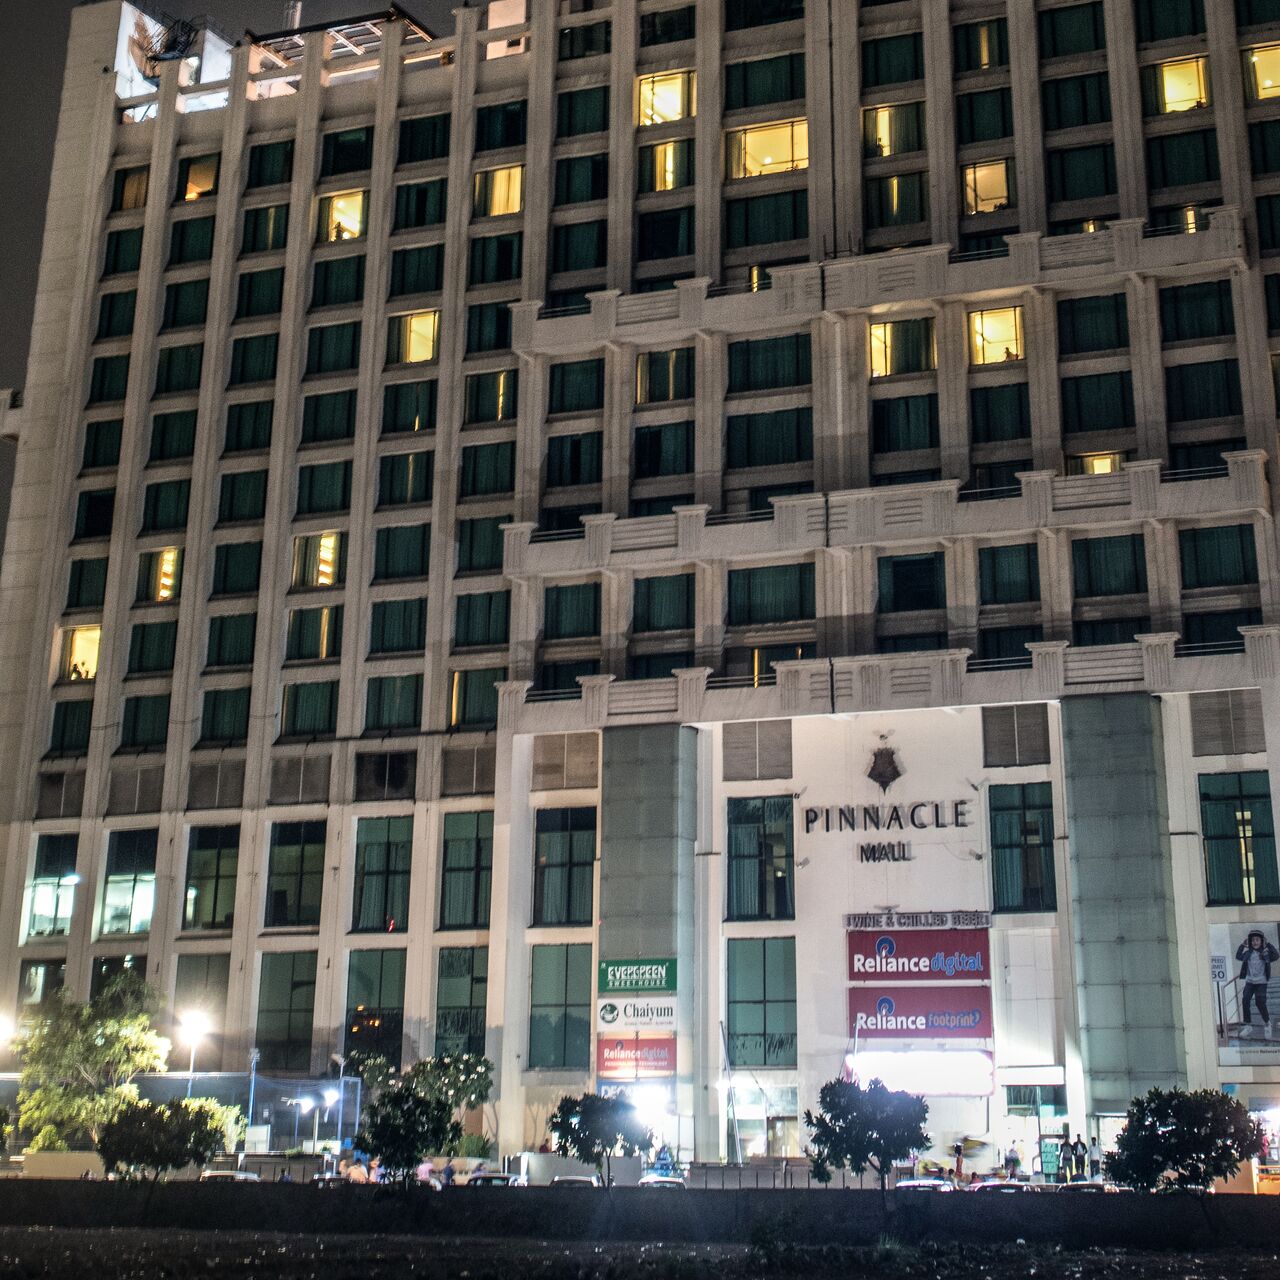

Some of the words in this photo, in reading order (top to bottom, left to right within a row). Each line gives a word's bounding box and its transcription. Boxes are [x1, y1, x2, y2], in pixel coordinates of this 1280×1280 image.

[804, 801, 970, 834] PINNACLE
[859, 841, 913, 863] MALL
[852, 915, 883, 928] WINE
[897, 913, 948, 927] CHILLED
[853, 954, 930, 973] Reliance
[930, 952, 984, 976] digital
[623, 1003, 674, 1021] Chaiyum
[856, 1013, 926, 1031] Reliance
[927, 1012, 976, 1029] footprint
[604, 1047, 640, 1059] Reliance
